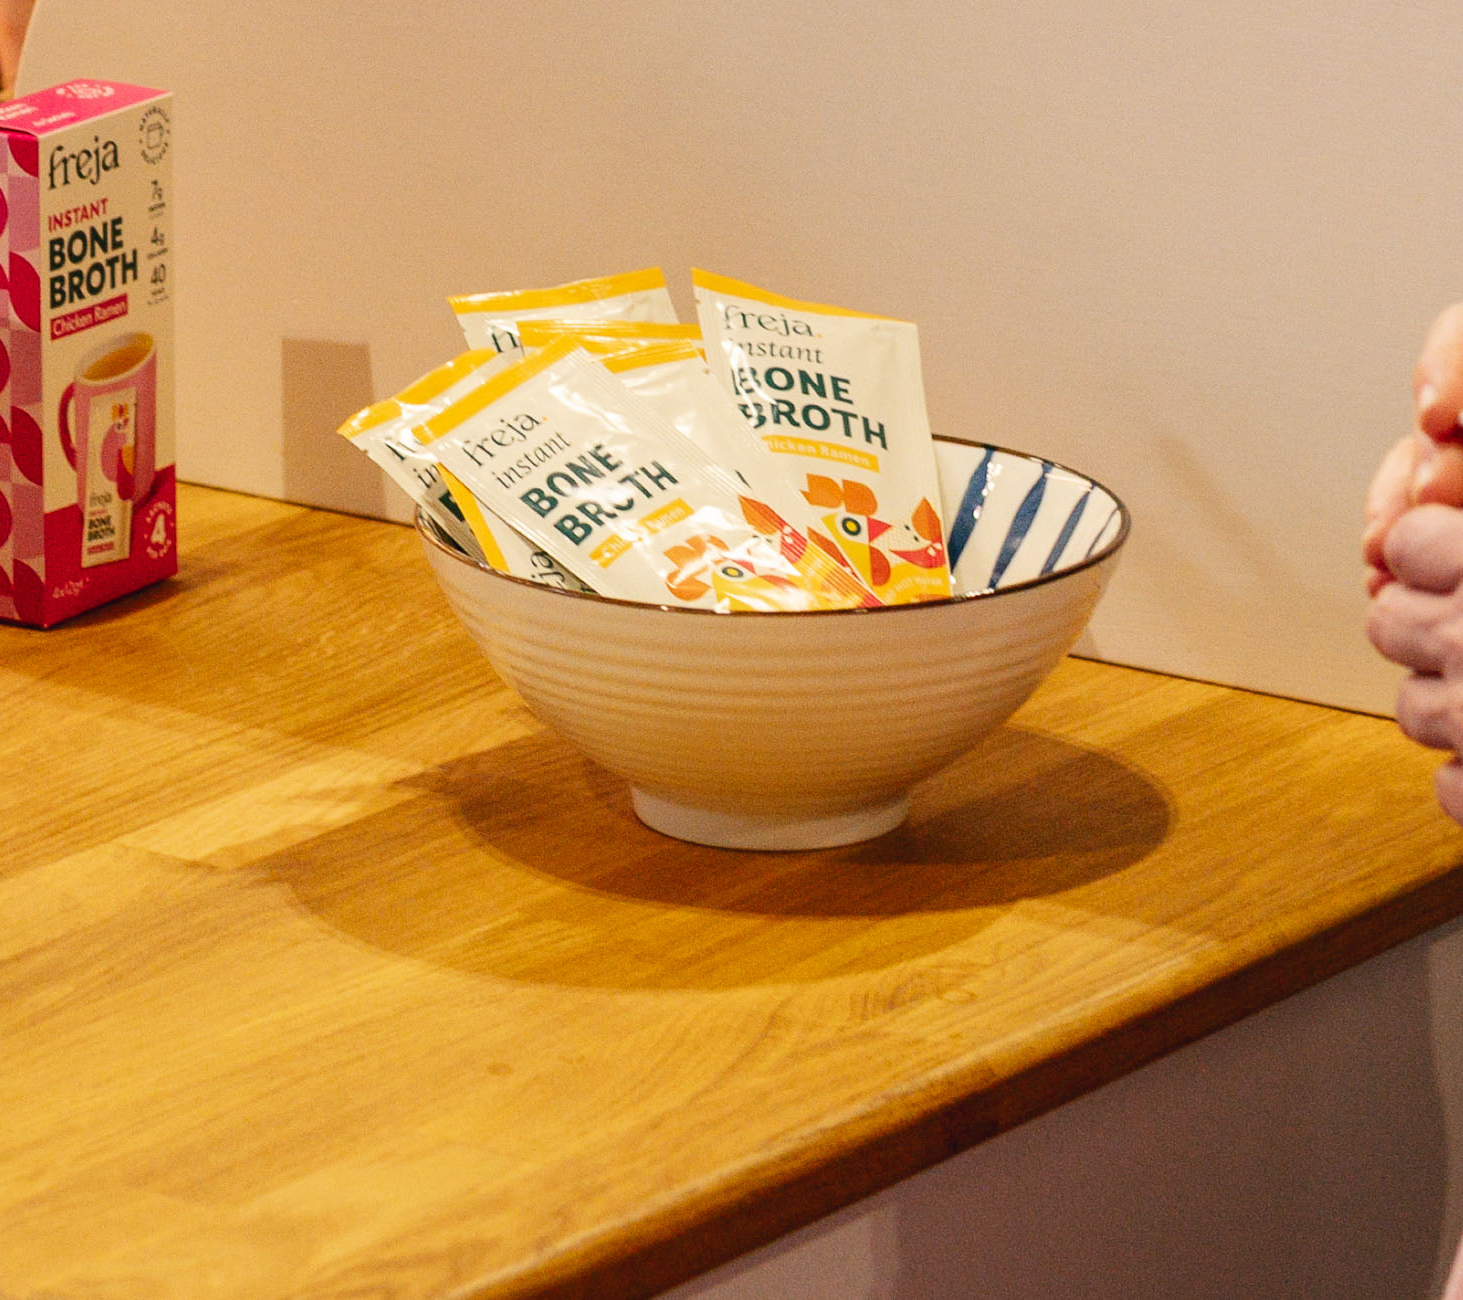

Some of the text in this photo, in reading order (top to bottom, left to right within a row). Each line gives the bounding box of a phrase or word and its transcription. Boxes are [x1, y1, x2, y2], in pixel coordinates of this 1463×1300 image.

[48, 135, 120, 190] freja
[48, 198, 109, 233] INSTANT
[49, 216, 124, 272] BONE
[49, 248, 138, 309] BROTH
[731, 365, 854, 406] BONE
[737, 398, 889, 451] BROTH
[490, 431, 572, 490] instant
[519, 442, 624, 519] BONE
[820, 445, 871, 468] Ramen
[150, 513, 167, 545] 4
